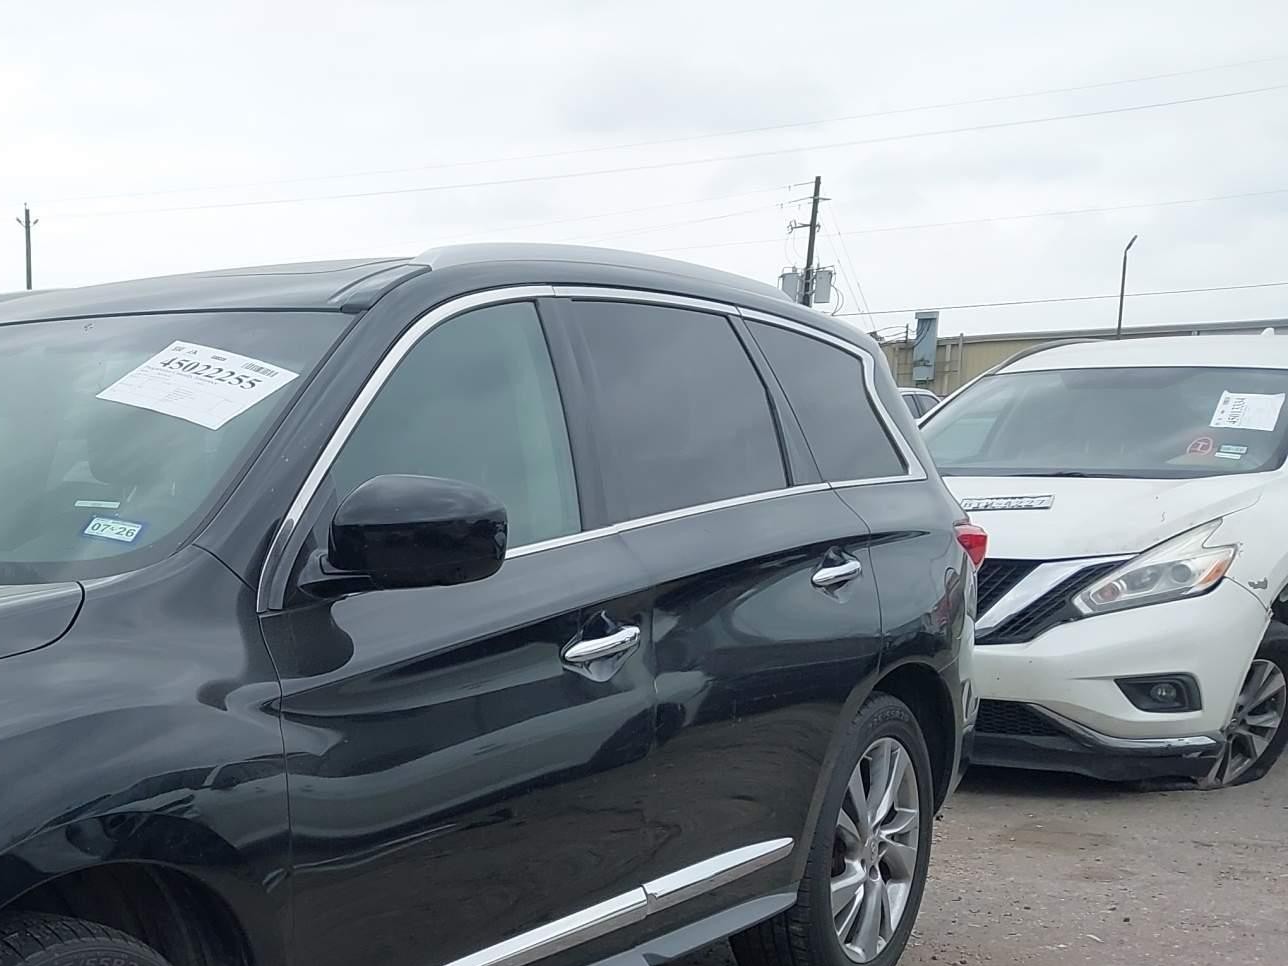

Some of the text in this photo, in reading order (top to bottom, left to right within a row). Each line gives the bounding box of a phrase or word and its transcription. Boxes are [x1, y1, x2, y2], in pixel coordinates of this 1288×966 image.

[160, 356, 262, 390] 45022255
[91, 522, 136, 538] 07 26
